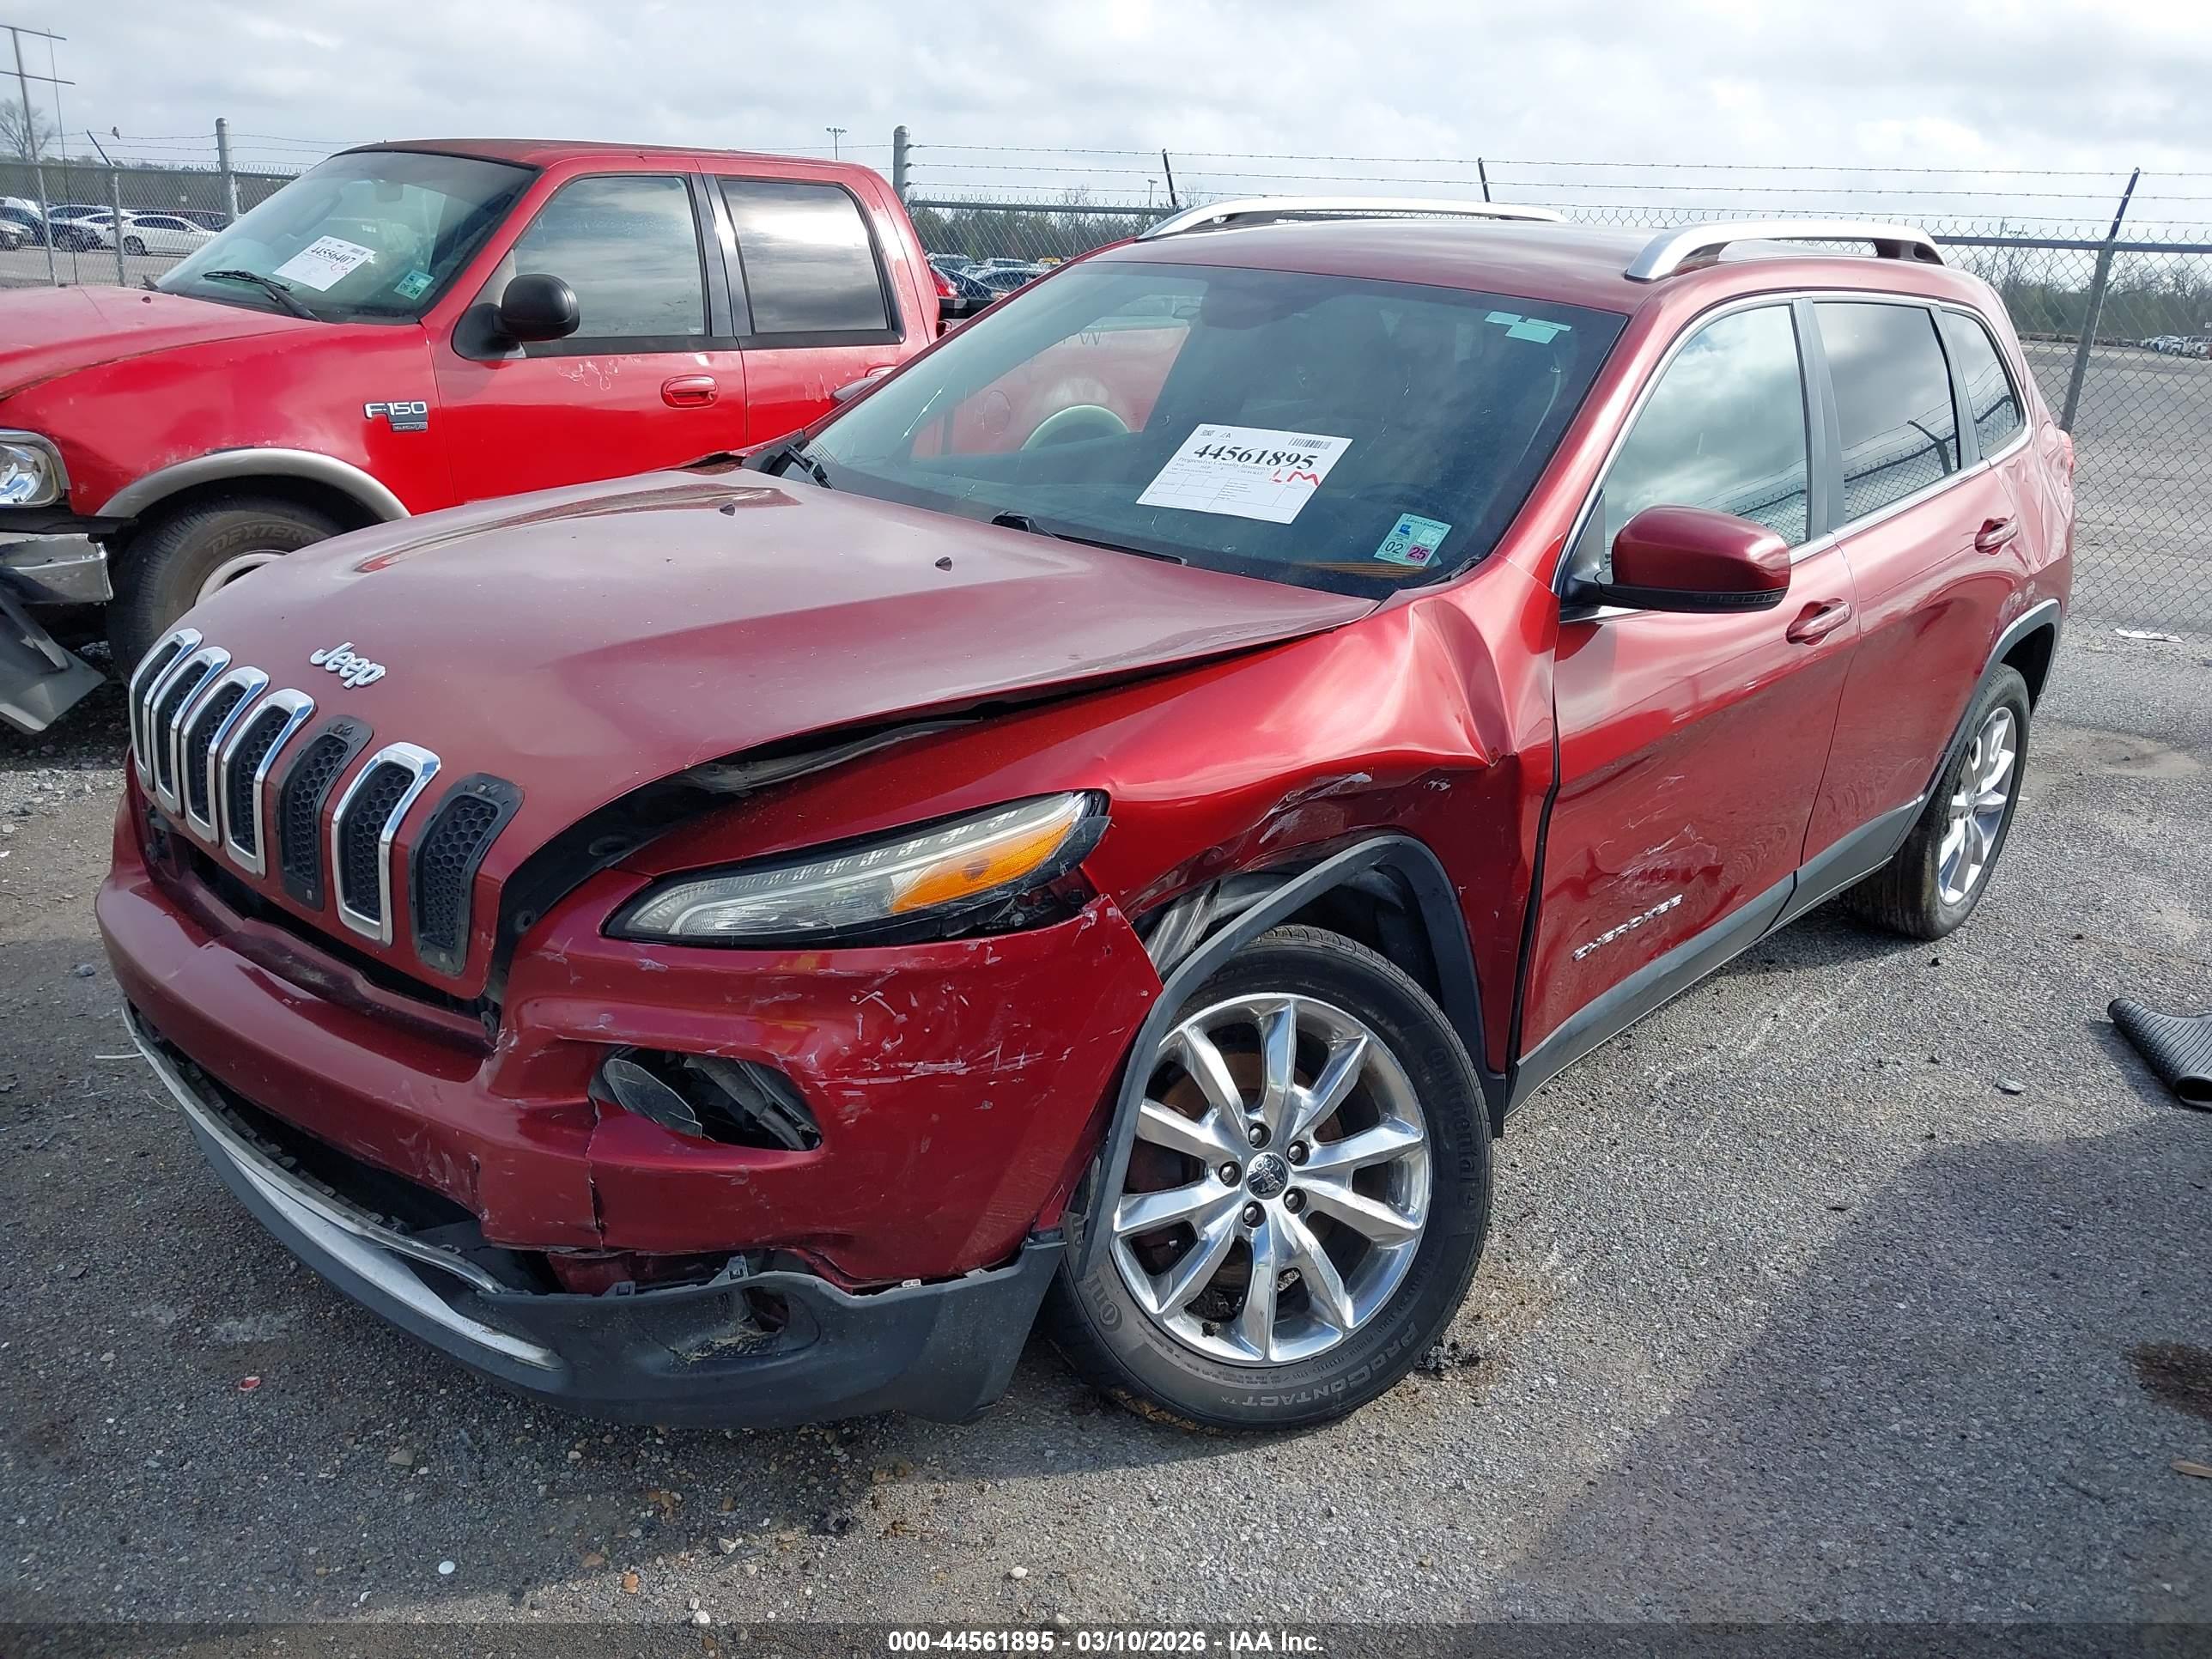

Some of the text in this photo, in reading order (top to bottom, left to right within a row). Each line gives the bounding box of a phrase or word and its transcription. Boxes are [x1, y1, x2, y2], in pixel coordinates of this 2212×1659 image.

[310, 246, 356, 265] 44556407
[1194, 443, 1318, 470] 44561895
[1385, 541, 1404, 554] 02
[1408, 546, 1429, 560] 25
[310, 641, 386, 689] Jeep
[1573, 894, 1683, 962] CHEROKEE
